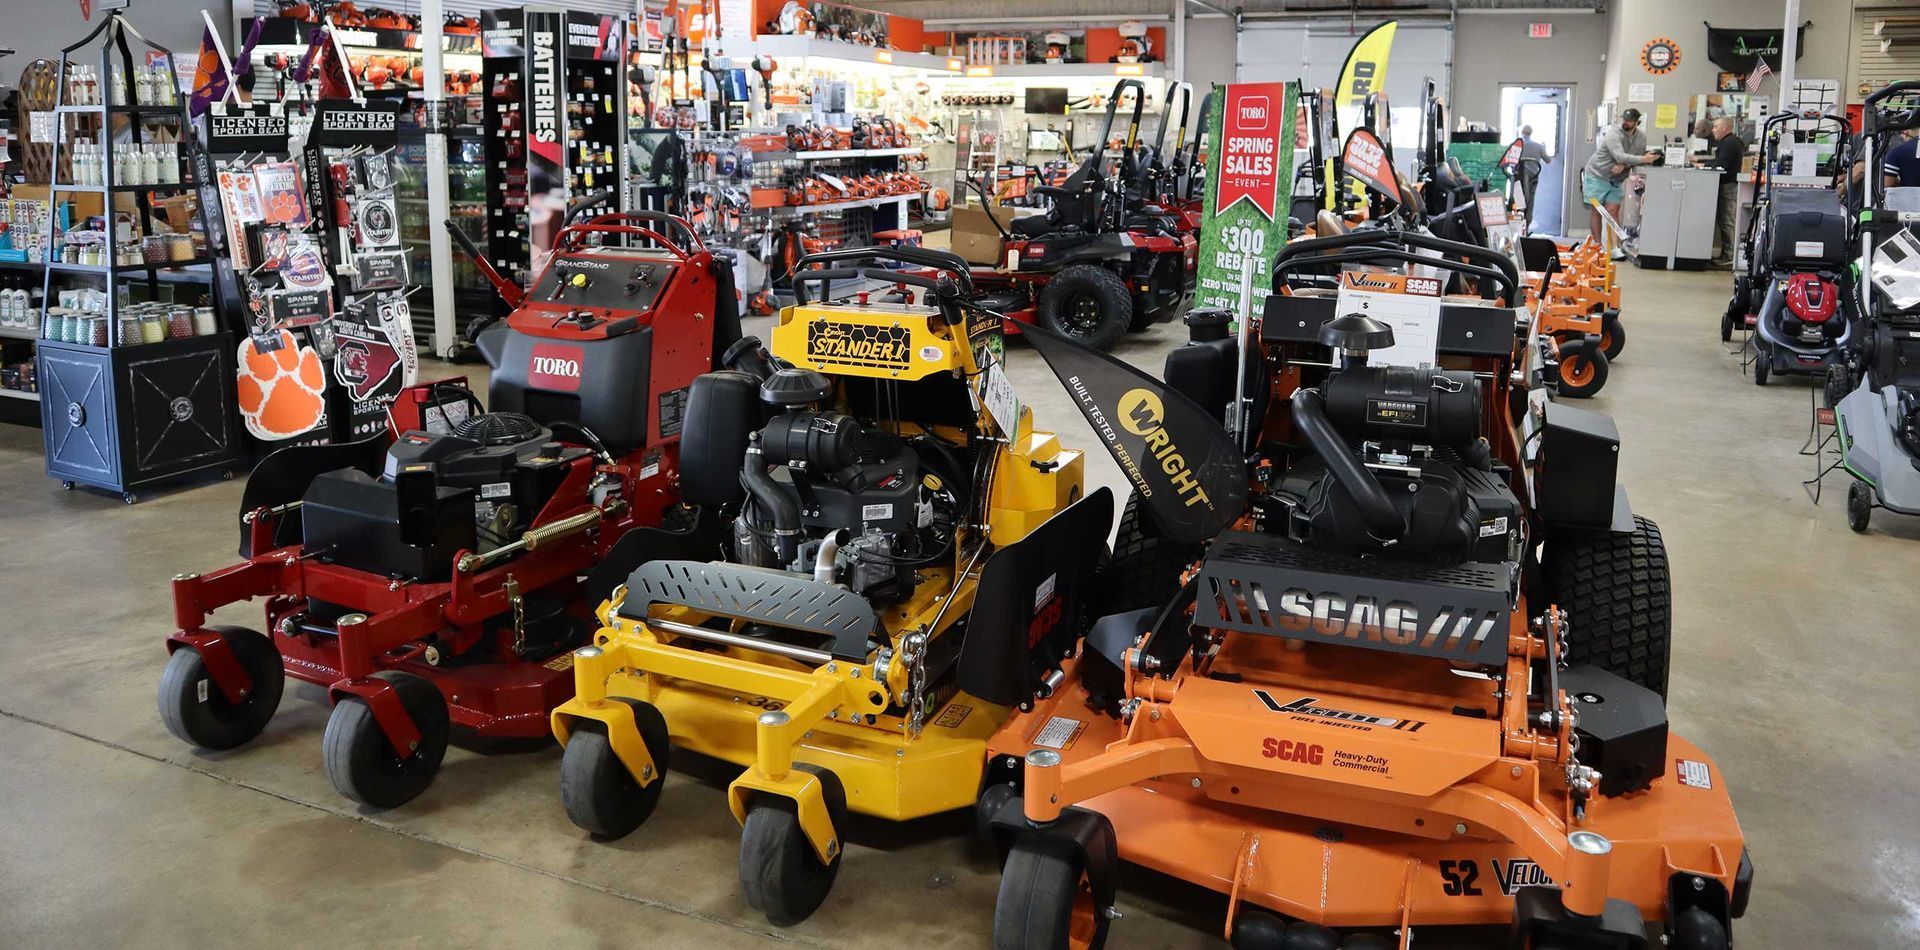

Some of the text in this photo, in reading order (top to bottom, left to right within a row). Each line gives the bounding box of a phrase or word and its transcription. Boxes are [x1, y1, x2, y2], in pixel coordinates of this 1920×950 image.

[569, 36, 601, 47] BATTERIES
[533, 31, 556, 143] BATTERIES
[323, 112, 395, 122] LICENSED
[1241, 107, 1265, 119] TORO
[212, 126, 286, 136] SPORTS GEAR
[213, 118, 285, 128] LICENSED
[322, 121, 395, 130] SPORTS GEAR
[1228, 137, 1274, 154] SPRING
[1225, 155, 1273, 176] SALES
[1234, 178, 1260, 189] EVENT
[1221, 226, 1265, 255] $300
[1406, 279, 1438, 291] SCAG
[815, 338, 895, 359] STANDER
[533, 357, 576, 376] TORO
[1069, 375, 1153, 500] BUILT. TESTED. PERFECTED.
[1279, 586, 1419, 646] SCAG
[1261, 737, 1324, 766] SCAG
[1334, 750, 1388, 766] Heavy-Duty
[1332, 758, 1389, 774] Commercial
[1439, 859, 1483, 896] 52
